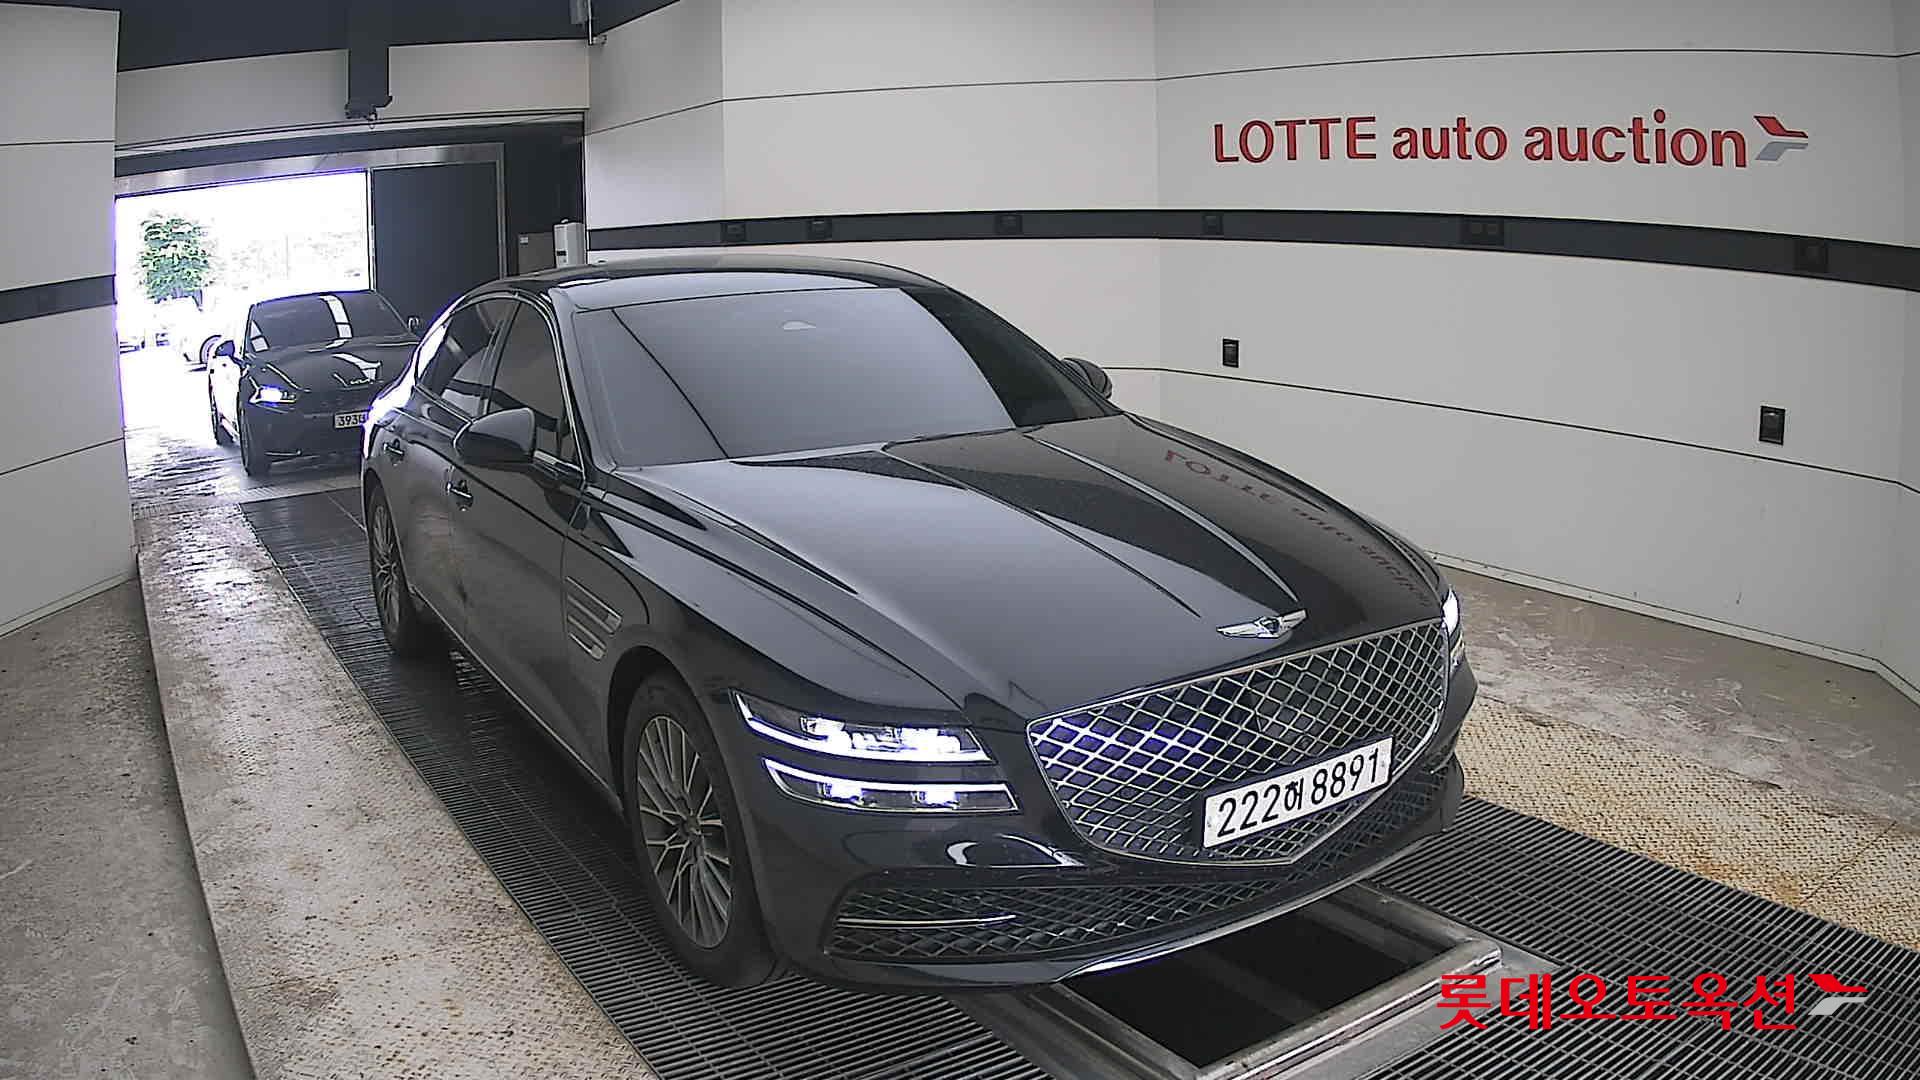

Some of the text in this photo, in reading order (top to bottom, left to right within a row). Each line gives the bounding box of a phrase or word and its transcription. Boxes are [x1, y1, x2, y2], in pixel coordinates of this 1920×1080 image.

[1214, 109, 1747, 168] LOTTE auto auction
